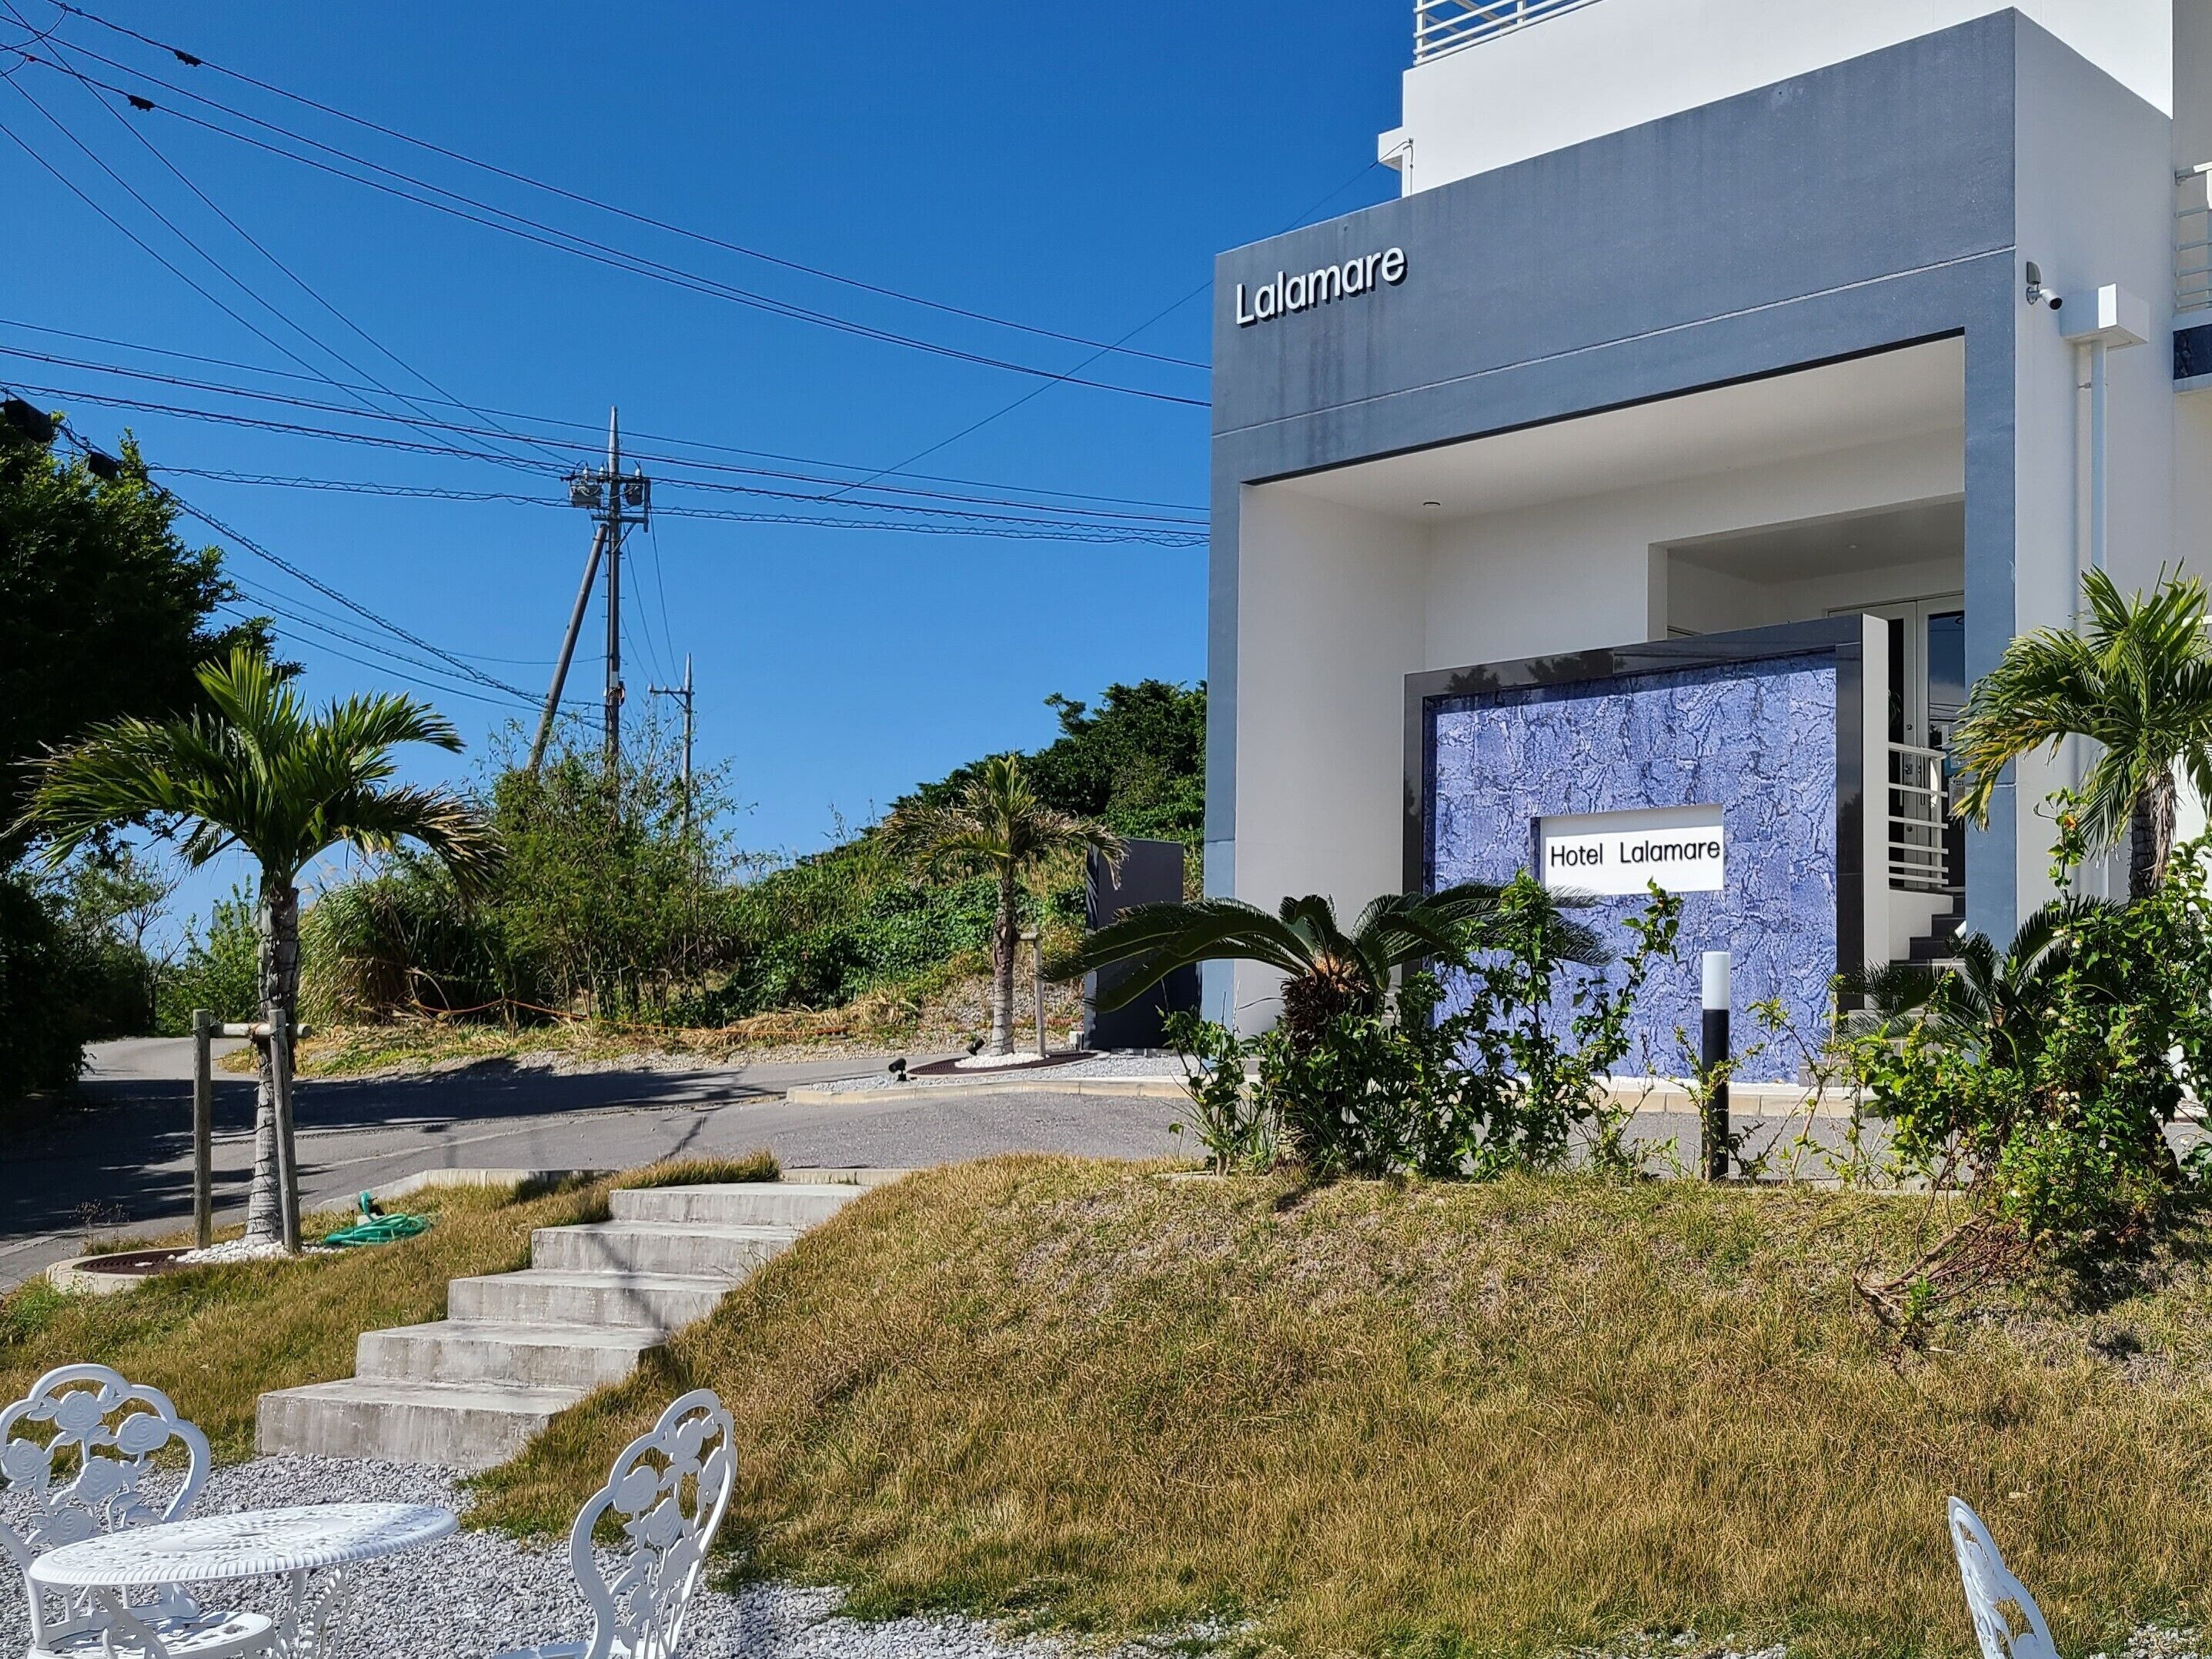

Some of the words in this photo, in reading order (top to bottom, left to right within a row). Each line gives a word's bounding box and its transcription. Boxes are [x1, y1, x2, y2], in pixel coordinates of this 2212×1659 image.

[1236, 247, 1405, 325] Lalamare
[1551, 843, 1603, 867] Hotel
[1619, 840, 1721, 863] Lalamare
